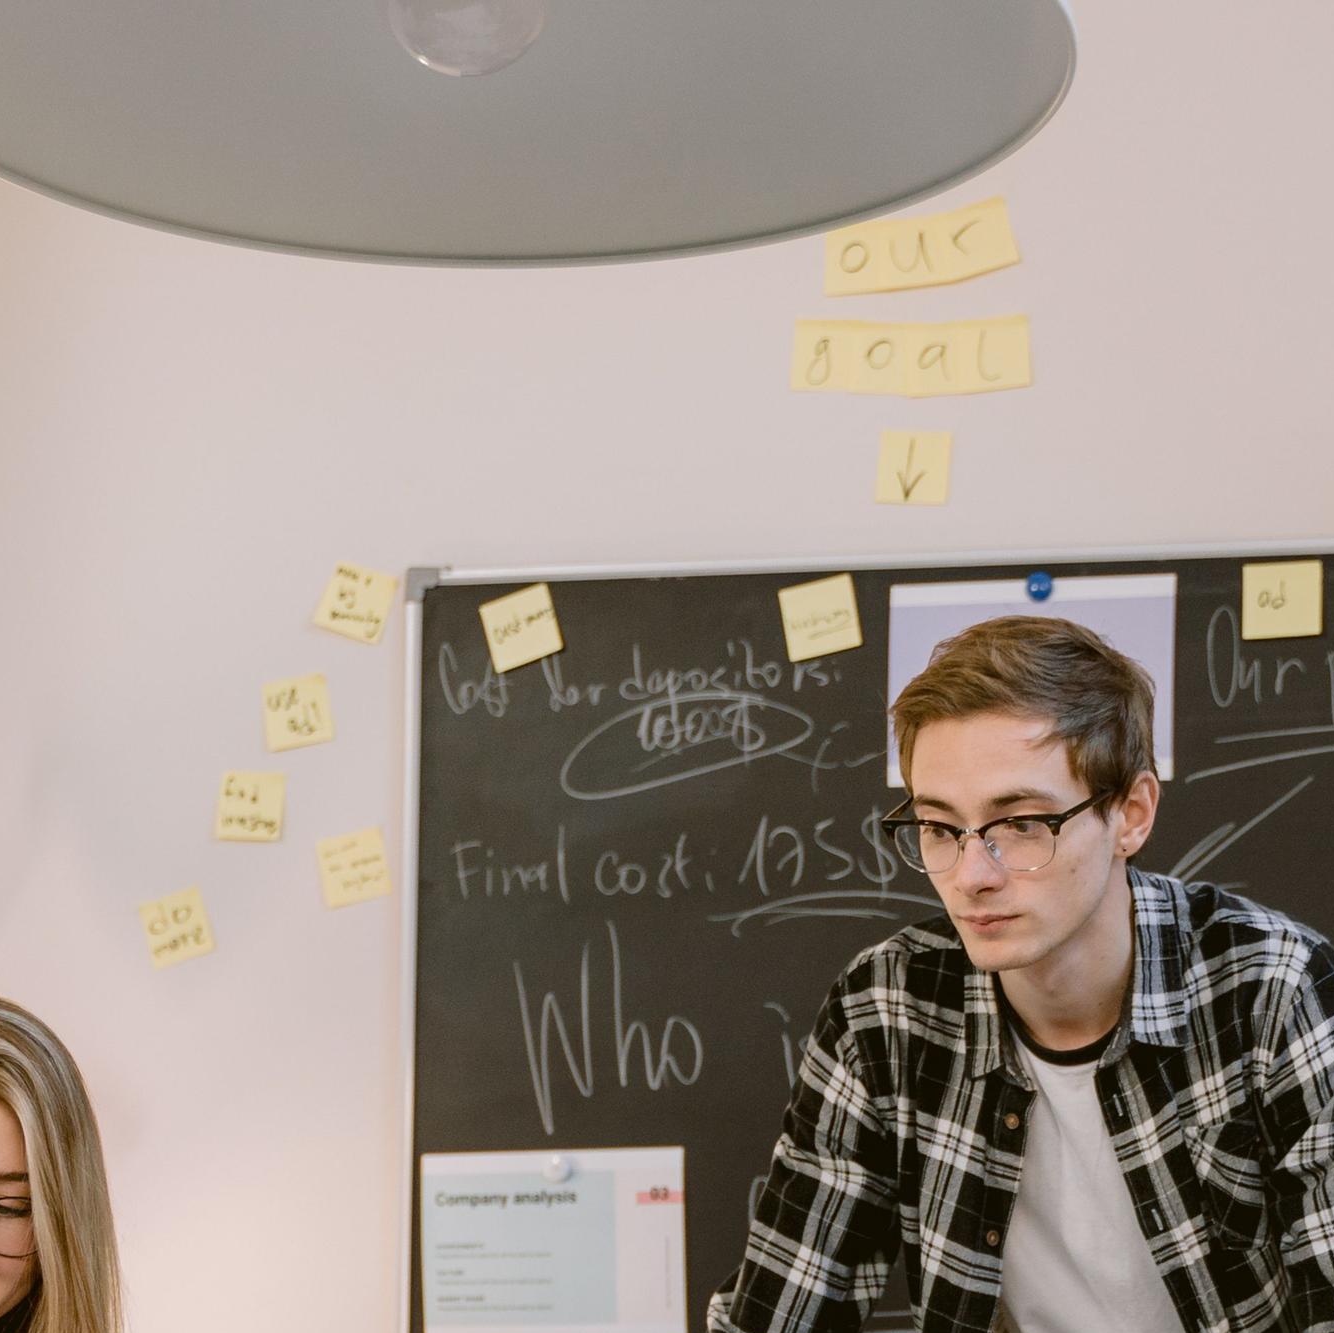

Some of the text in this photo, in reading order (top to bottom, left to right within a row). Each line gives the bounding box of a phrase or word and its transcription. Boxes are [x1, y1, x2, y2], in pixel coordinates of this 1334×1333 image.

[839, 218, 981, 274] our
[805, 328, 1002, 386] goal
[1207, 605, 1306, 708] Our
[451, 826, 570, 902] Final
[512, 920, 704, 1136] Who
[436, 1192, 508, 1209] Company
[512, 1188, 578, 1207] analysis
